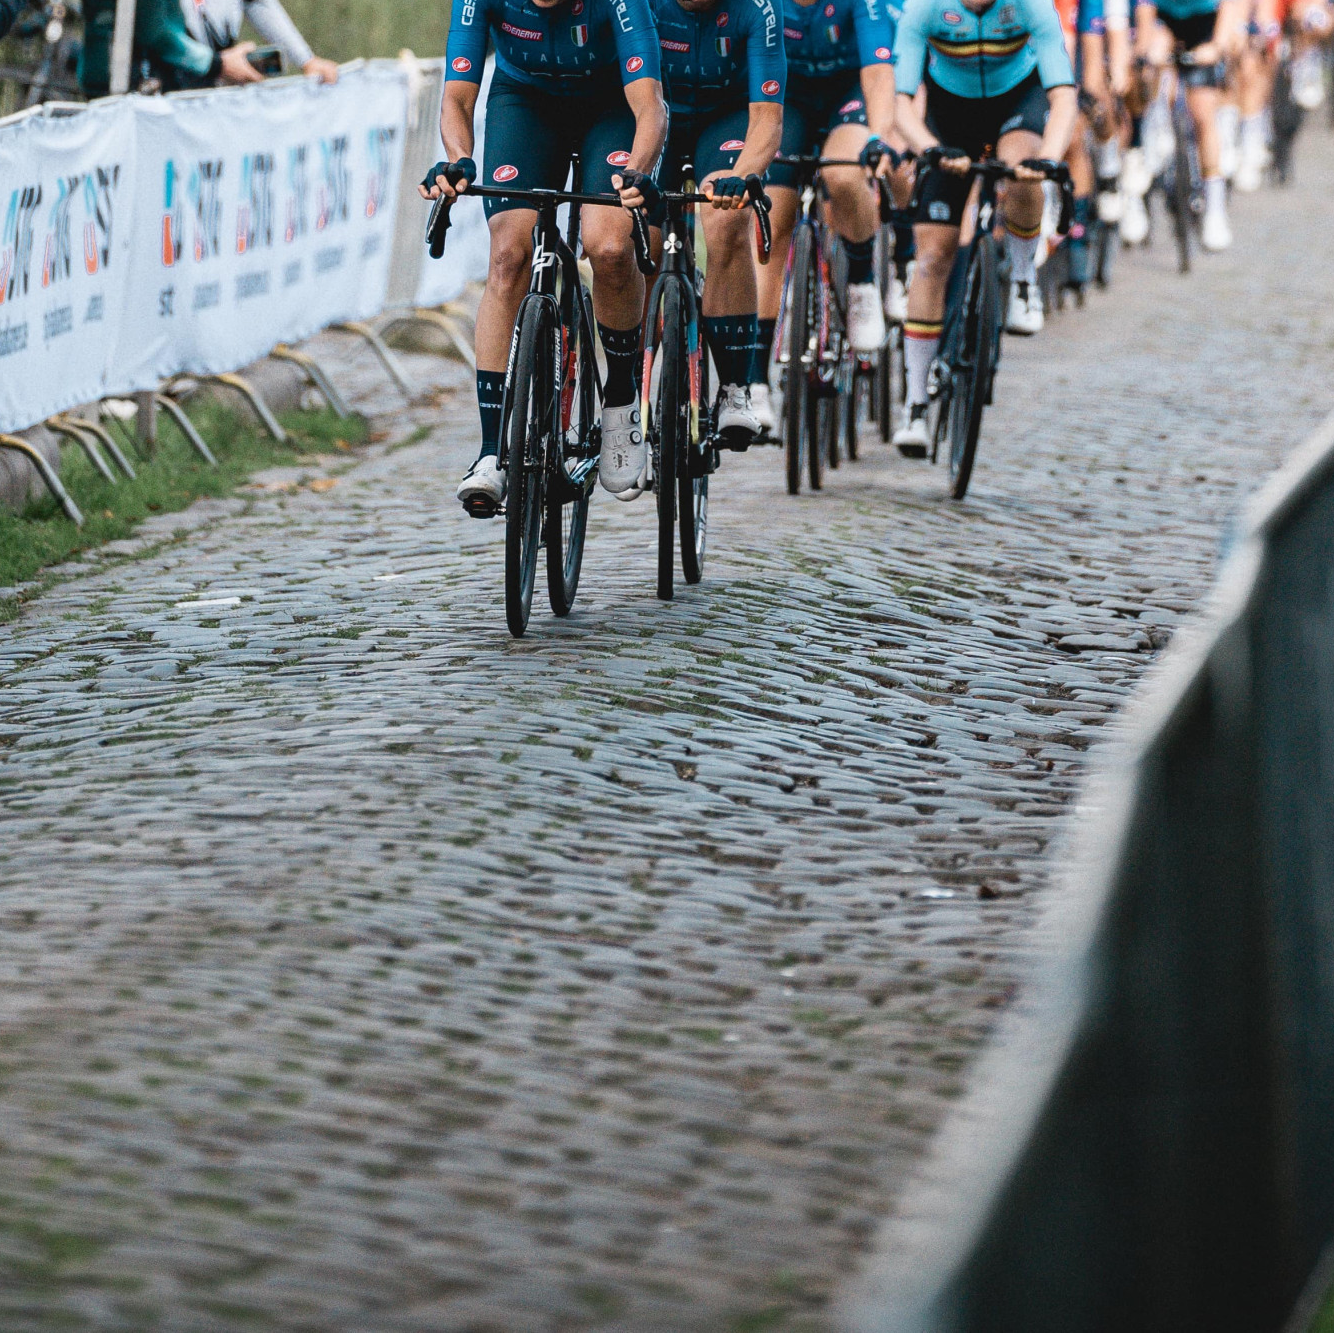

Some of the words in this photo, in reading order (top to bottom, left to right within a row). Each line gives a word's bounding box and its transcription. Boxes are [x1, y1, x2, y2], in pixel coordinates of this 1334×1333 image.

[510, 27, 542, 40] ENERVIT
[504, 325, 520, 390] LAPIERRE
[553, 327, 561, 391] LAPIERRE
